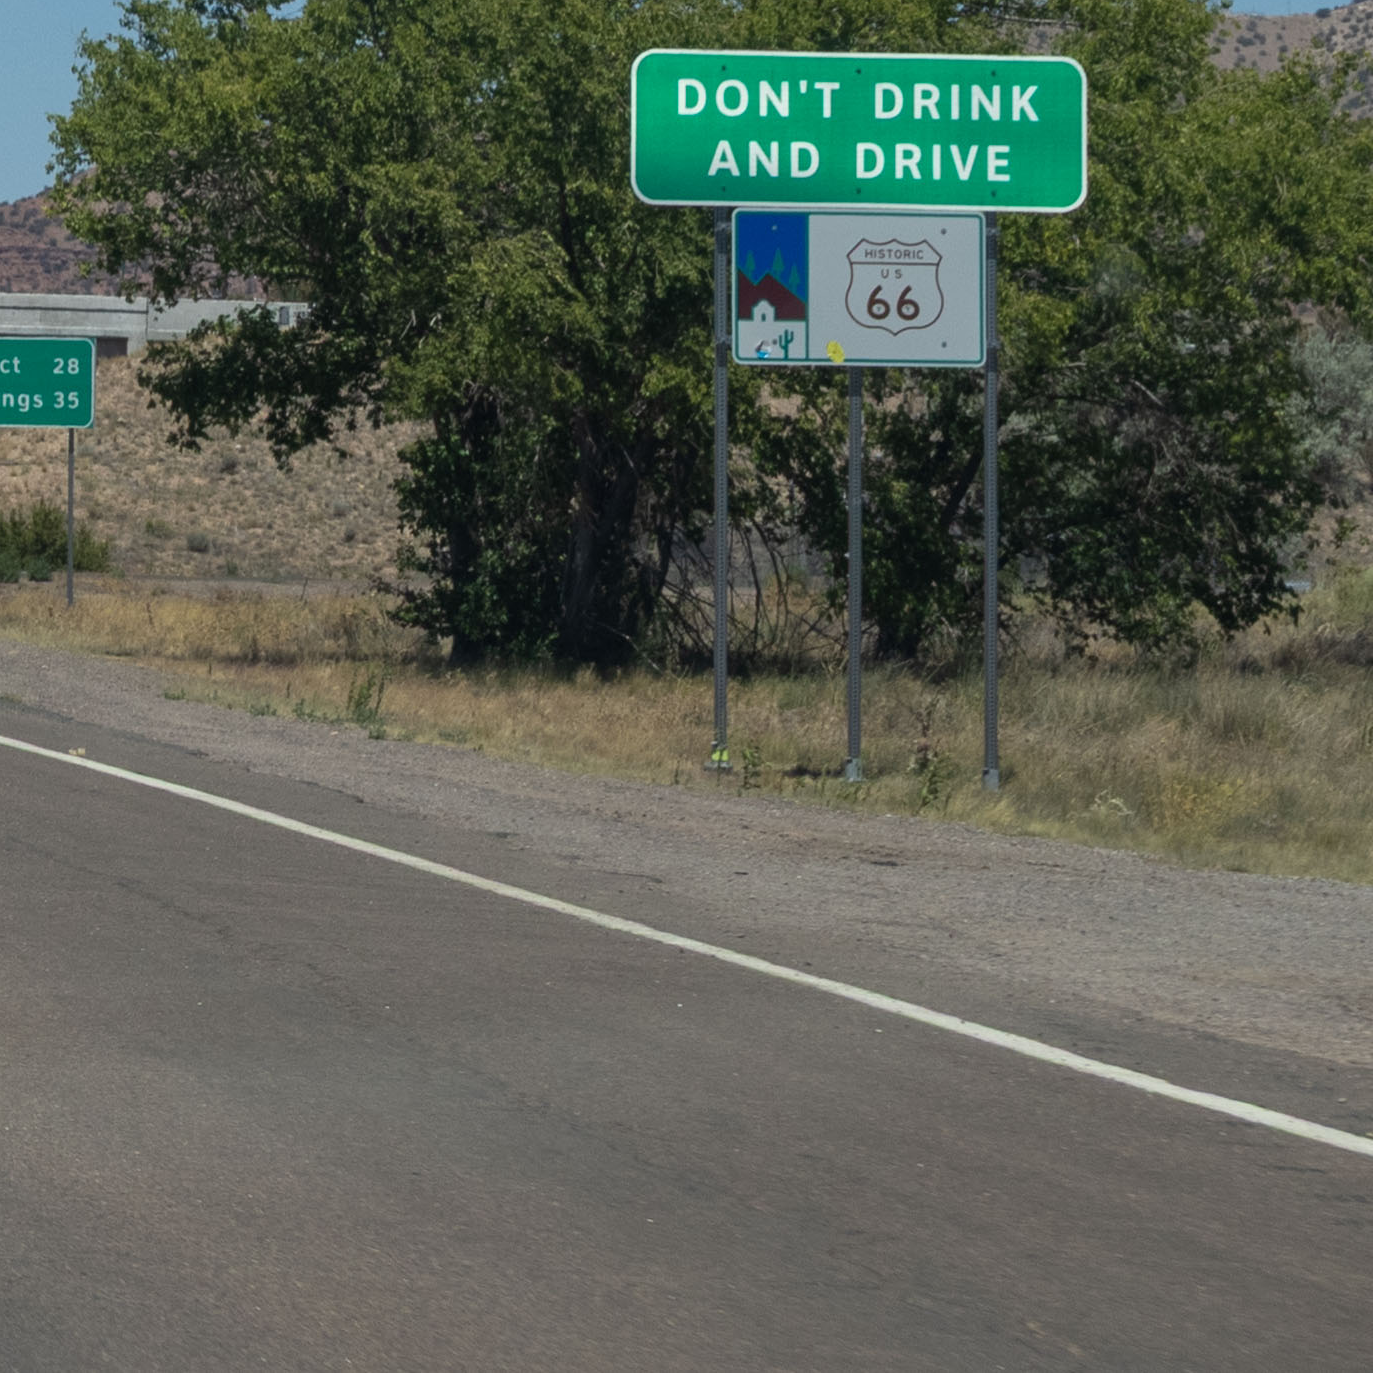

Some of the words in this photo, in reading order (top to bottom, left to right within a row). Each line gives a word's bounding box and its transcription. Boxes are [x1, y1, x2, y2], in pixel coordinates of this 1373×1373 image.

[677, 78, 840, 118] DON'T
[874, 82, 1039, 121] DRINK
[707, 140, 820, 178] AND
[855, 142, 1011, 182] DRIVE
[864, 249, 924, 260] HISTORIC
[866, 284, 920, 321] 66
[53, 357, 80, 375] 28
[53, 391, 80, 409] 35
